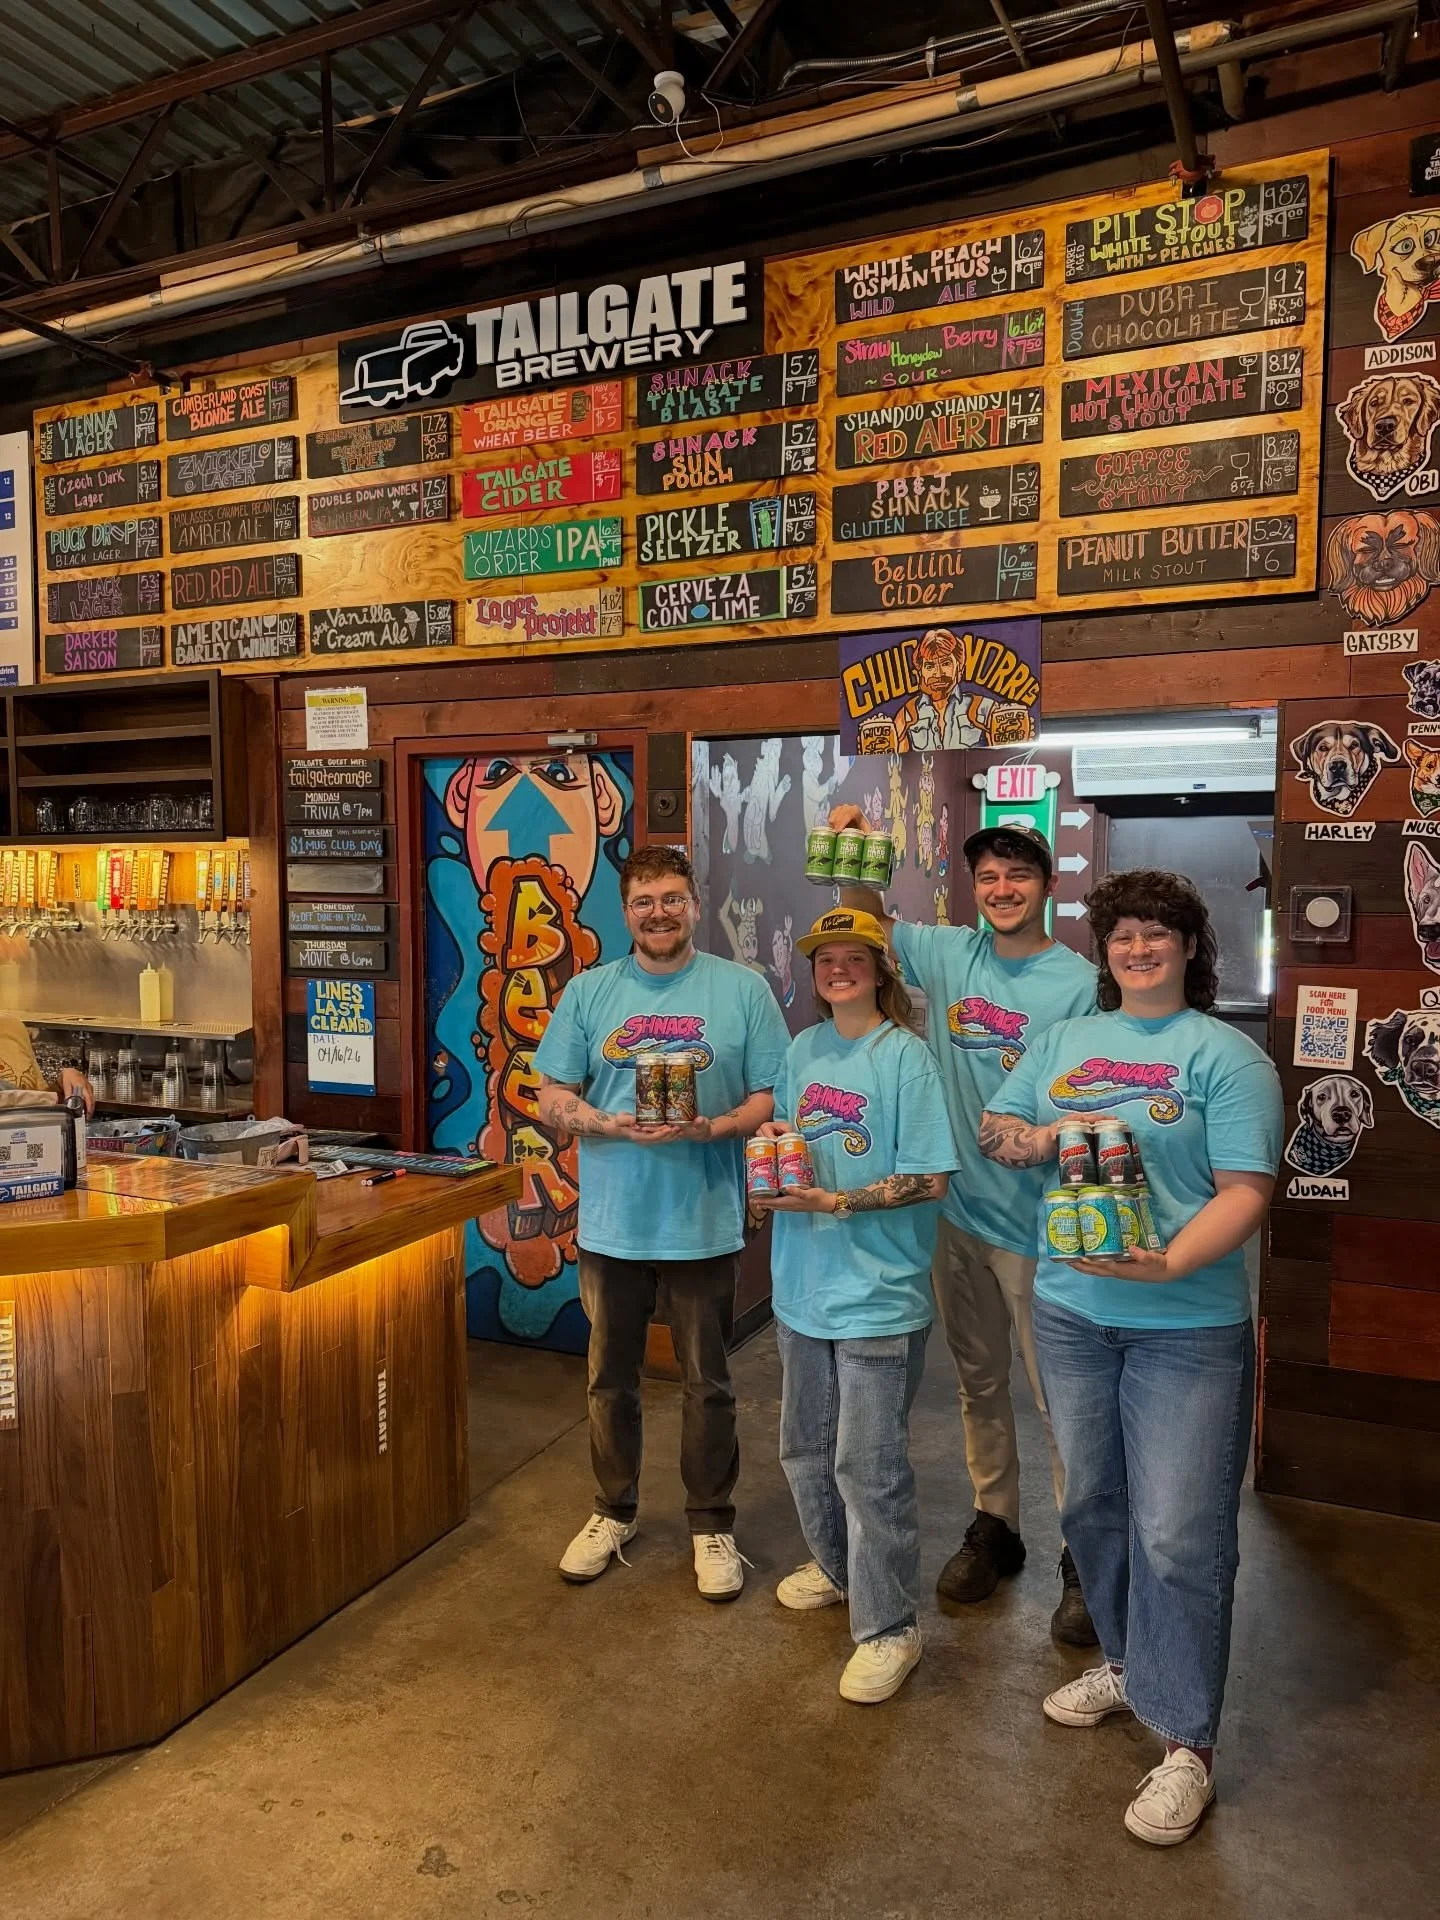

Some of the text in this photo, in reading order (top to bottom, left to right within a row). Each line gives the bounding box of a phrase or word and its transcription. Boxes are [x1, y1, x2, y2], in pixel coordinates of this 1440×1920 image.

[1093, 209, 1141, 246] PIT
[1090, 220, 1240, 261] WHITE STOUT
[843, 236, 1002, 284] WHITE PEACH
[1066, 239, 1077, 277] BARREL
[1106, 236, 1236, 272] WITH PEACHES
[850, 280, 978, 320] WILD ALE
[1120, 281, 1219, 318] DUBAI
[466, 260, 748, 366] TAILGATE
[1268, 315, 1297, 326] TULIP
[1066, 300, 1085, 354] DOUGH
[1091, 307, 1240, 350] CHOCOLATE
[495, 328, 714, 388] BREWERY
[890, 325, 998, 367] Honeydew Berry
[1367, 343, 1434, 367] ADDISON
[790, 354, 818, 375] 5%
[1269, 352, 1301, 374] 8.1%
[650, 360, 752, 392] SHNACK
[1085, 358, 1224, 400] MEXICAN
[172, 382, 268, 417] CUMBERLAND COAST
[646, 375, 763, 411] TAILGATE
[1011, 392, 1042, 415] 4%
[1070, 378, 1247, 422] HOT CHOCOLATE
[189, 397, 266, 432] BLONDE ALE
[474, 391, 568, 423] TAILGATE
[596, 409, 617, 428] $5
[660, 395, 741, 423] BLAST
[843, 392, 1003, 432] SHANDOO SHANDY
[1107, 406, 1191, 431] STOUT
[57, 409, 118, 441] VIENNA
[423, 414, 447, 432] 7.7%
[483, 410, 565, 433] ORANGE
[790, 423, 816, 445] 5%
[64, 429, 115, 458] LAGER
[473, 423, 574, 449] WHEAT BEER
[652, 427, 757, 461] SHNACK
[854, 407, 1007, 464] RED ALERT
[178, 443, 265, 480] ZWICKEL
[476, 456, 573, 491] TAILGATE
[672, 449, 722, 477] SUN
[1095, 446, 1192, 476] COFFEE
[57, 473, 93, 496] Czech
[98, 468, 125, 487] Dark
[202, 466, 256, 491] LAGER
[424, 479, 447, 497] 7.5%
[596, 474, 615, 494] $7
[662, 466, 734, 491] POUCH
[1016, 471, 1039, 491] 5%
[1408, 473, 1437, 493] OBI
[74, 493, 104, 508] Lager
[312, 482, 419, 511] DOUBLE DOWN UNDER
[480, 480, 569, 511] CIDER
[870, 484, 970, 519] SHNACK
[178, 516, 266, 547] AMBER ALE
[645, 503, 730, 542] PICKLE
[840, 507, 971, 540] GLUTEN FREE
[1253, 518, 1294, 541] 5.2%
[50, 526, 87, 554] PUCK
[556, 525, 601, 563] IPA
[640, 529, 742, 562] SELTZER
[1066, 520, 1249, 570] PEANUT BUTTER
[4, 559, 14, 567] 2.5
[55, 550, 121, 567] BLACK LAGER
[474, 551, 542, 576] ORDER
[602, 557, 621, 566] PINT
[872, 549, 965, 585] Bellini
[1103, 559, 1208, 583] MILK STOUT
[1251, 547, 1280, 572] $6
[77, 576, 123, 599] BLACK
[210, 561, 275, 599] RED ALE
[791, 566, 815, 589] 5%
[4, 587, 14, 595] 2.5
[601, 594, 622, 611] 4.8%
[655, 573, 751, 608] CERVEZA
[5, 602, 15, 610] 2.5
[70, 597, 124, 621] LAGER
[327, 604, 396, 629] Vanilla
[646, 595, 760, 628] CON LIME
[176, 615, 263, 646] AMERICAN
[279, 617, 296, 635] 10%
[326, 622, 409, 650] Cream Ale
[65, 629, 118, 651] DARKER
[175, 636, 278, 665] BARLEY WINE
[1346, 632, 1415, 653] GATSBY
[64, 650, 117, 671] SAISON
[963, 632, 1041, 707] NORRIS
[863, 725, 891, 738] MUG
[292, 759, 324, 767] TAILGATE
[327, 758, 347, 766] GUEST
[288, 768, 373, 788] tailgateorange
[996, 767, 1038, 798] EXIT
[305, 792, 340, 802] MONDAY
[301, 802, 373, 820] TRIVIA @ 7PM
[302, 828, 333, 836] TUESDAY
[1307, 825, 1373, 839] HARLEY
[305, 840, 357, 850] MUG CLUB
[304, 940, 347, 950] THURSDAY
[299, 951, 333, 967] MOVIE
[316, 980, 364, 1004] LINES
[1309, 990, 1347, 1000] SCAN HERE
[1320, 999, 1334, 1007] FOR
[315, 998, 364, 1018] LAST
[1306, 1006, 1347, 1016] FOOD MENU
[310, 1014, 373, 1033] CLEANED
[617, 1014, 705, 1048] SHNACK
[1067, 1057, 1179, 1089] SHNACK
[10, 1180, 59, 1196] TAILGATE
[1288, 1177, 1346, 1198] JUDAH
[377, 1368, 388, 1454] TAILGATE
